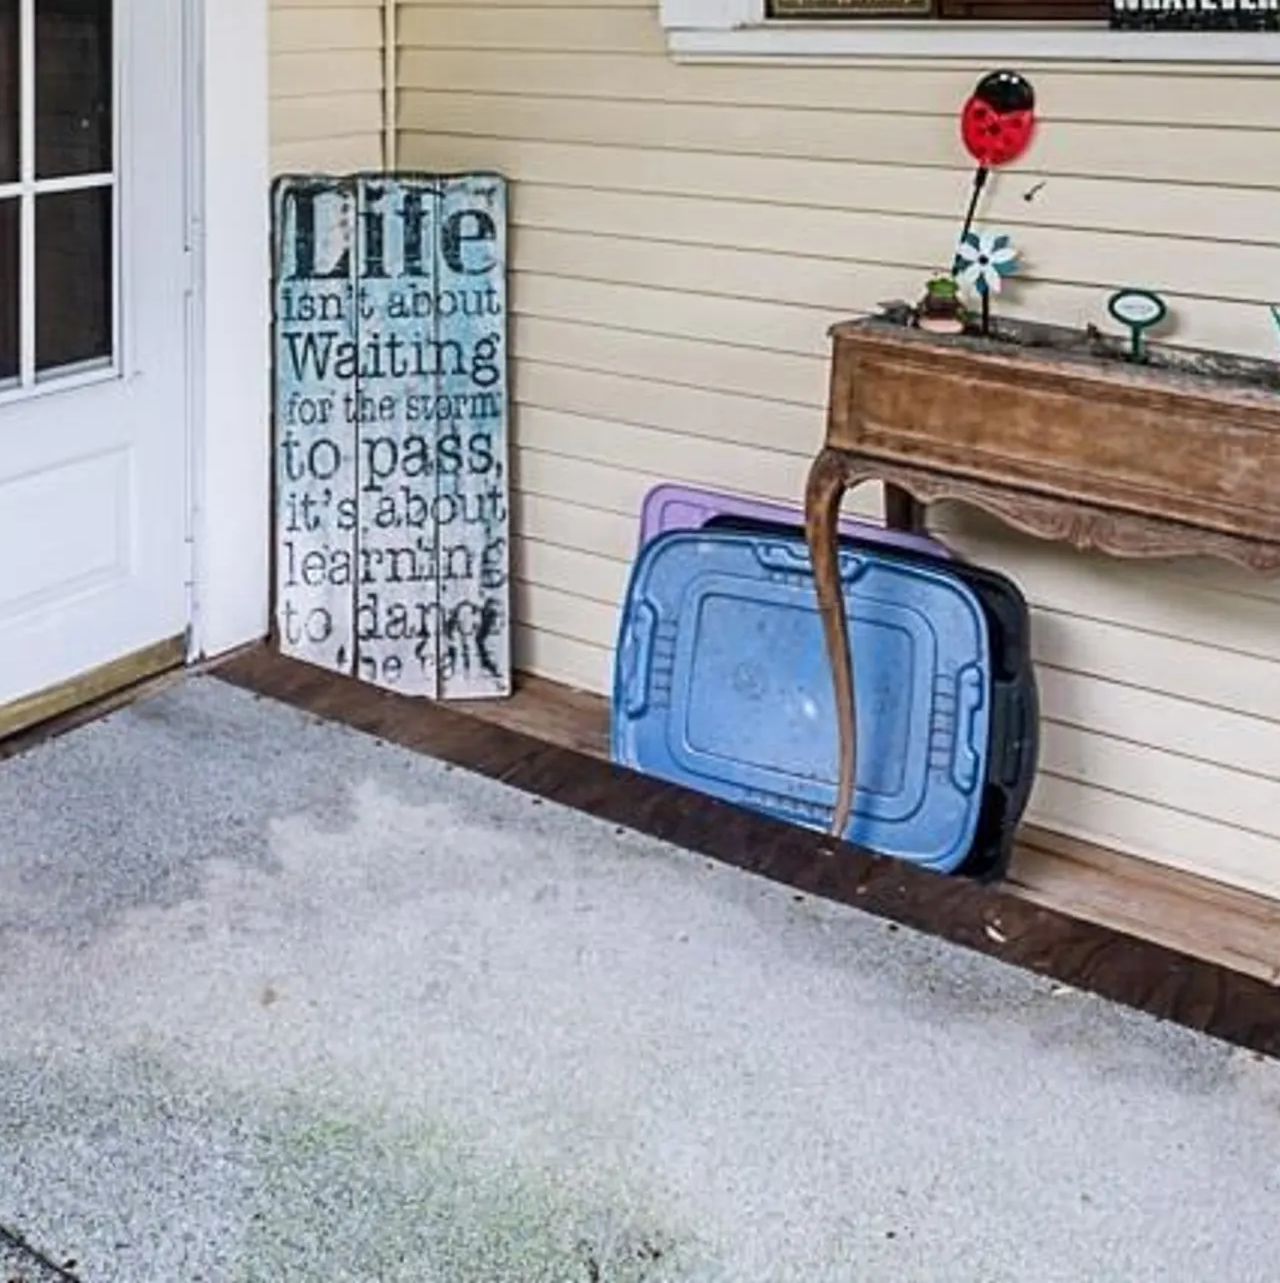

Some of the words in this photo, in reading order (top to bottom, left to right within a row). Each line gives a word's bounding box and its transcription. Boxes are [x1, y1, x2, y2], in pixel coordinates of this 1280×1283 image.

[283, 181, 498, 281] Life
[281, 284, 375, 322] isn't
[387, 283, 501, 319] about
[281, 331, 502, 388] Waiting
[287, 392, 334, 425] for
[344, 395, 396, 424] the
[405, 391, 500, 420] storm
[280, 430, 342, 481] to
[286, 487, 358, 532] it's
[375, 484, 506, 529] about
[283, 536, 505, 589] learning
[281, 600, 333, 645] to
